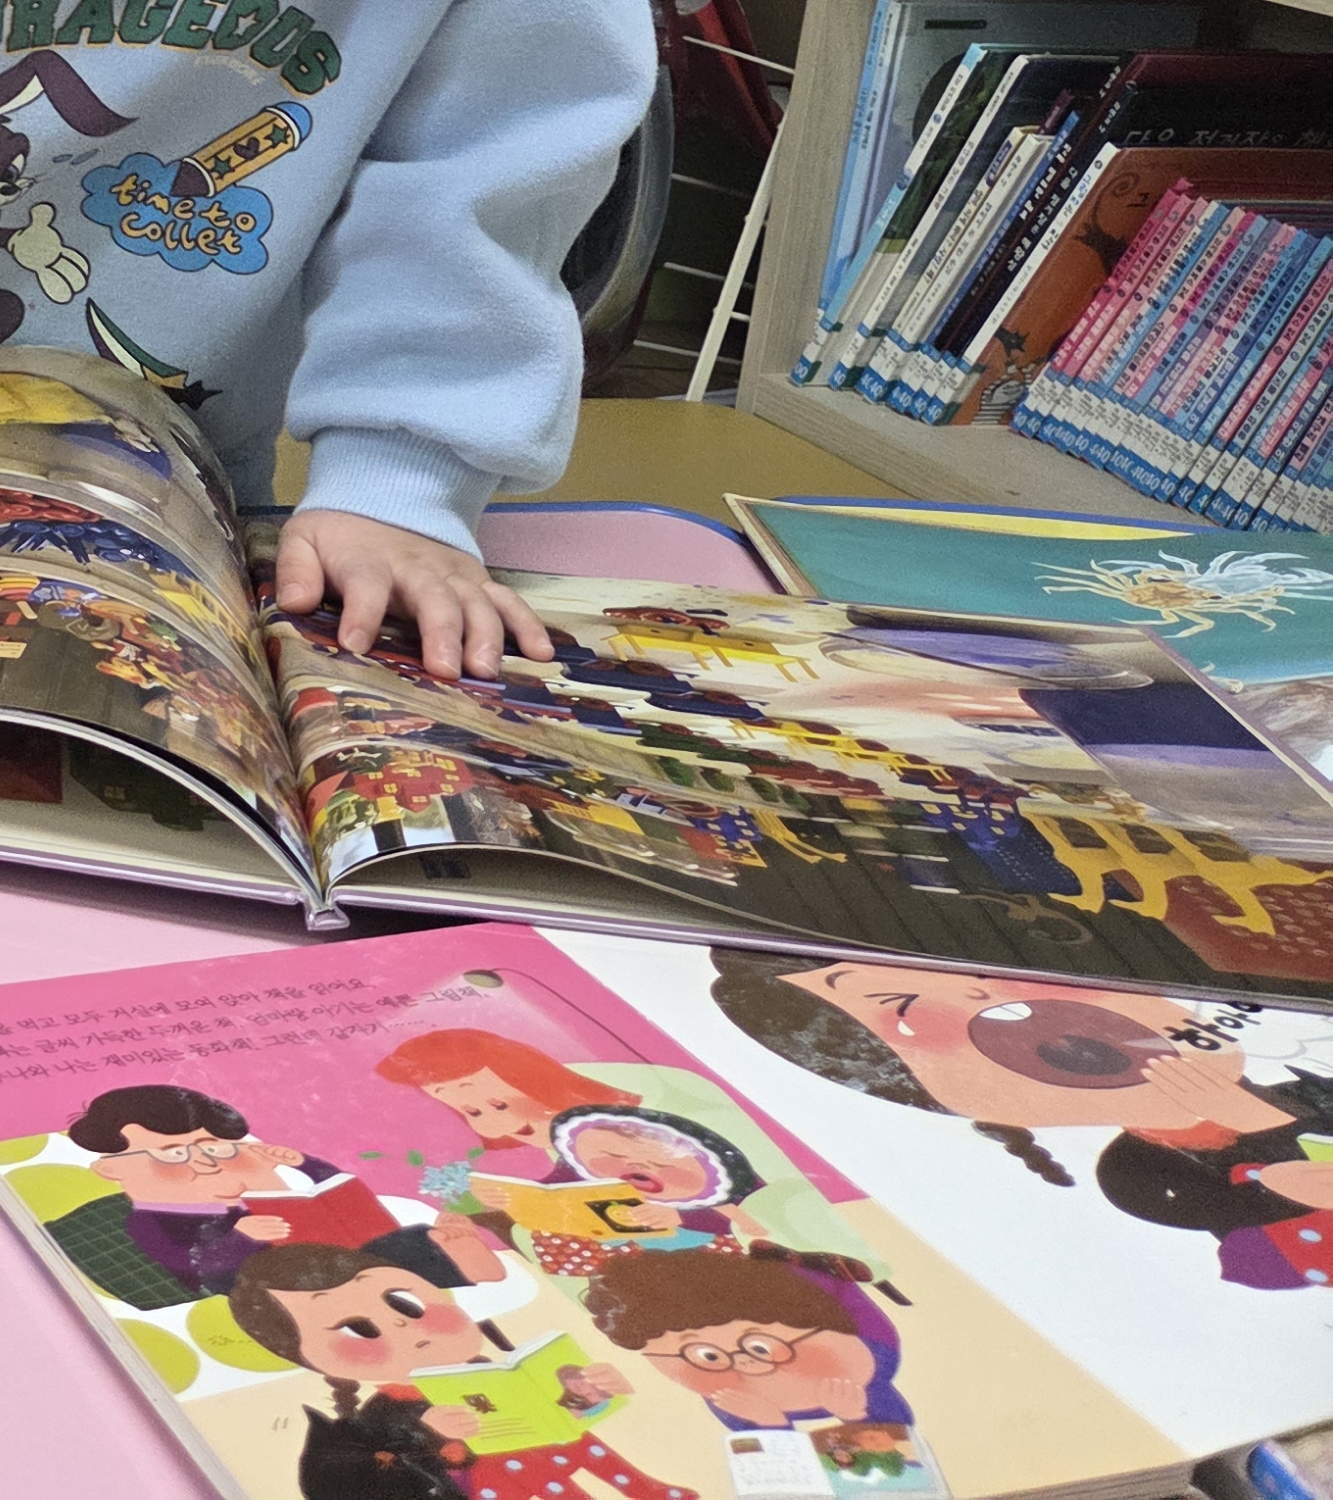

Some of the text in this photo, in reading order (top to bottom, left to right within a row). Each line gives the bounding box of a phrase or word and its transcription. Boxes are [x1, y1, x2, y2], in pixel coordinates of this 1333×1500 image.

[113, 172, 255, 234] time to
[15, 1016, 62, 1031] 먹고
[63, 1009, 104, 1024] 모두
[175, 995, 217, 1012] 모여
[263, 986, 306, 1000] 책을
[83, 1026, 147, 1046] 가득한
[311, 1001, 377, 1018] 아기는
[52, 1058, 99, 1074] 나는
[103, 1046, 187, 1068] 재미있는
